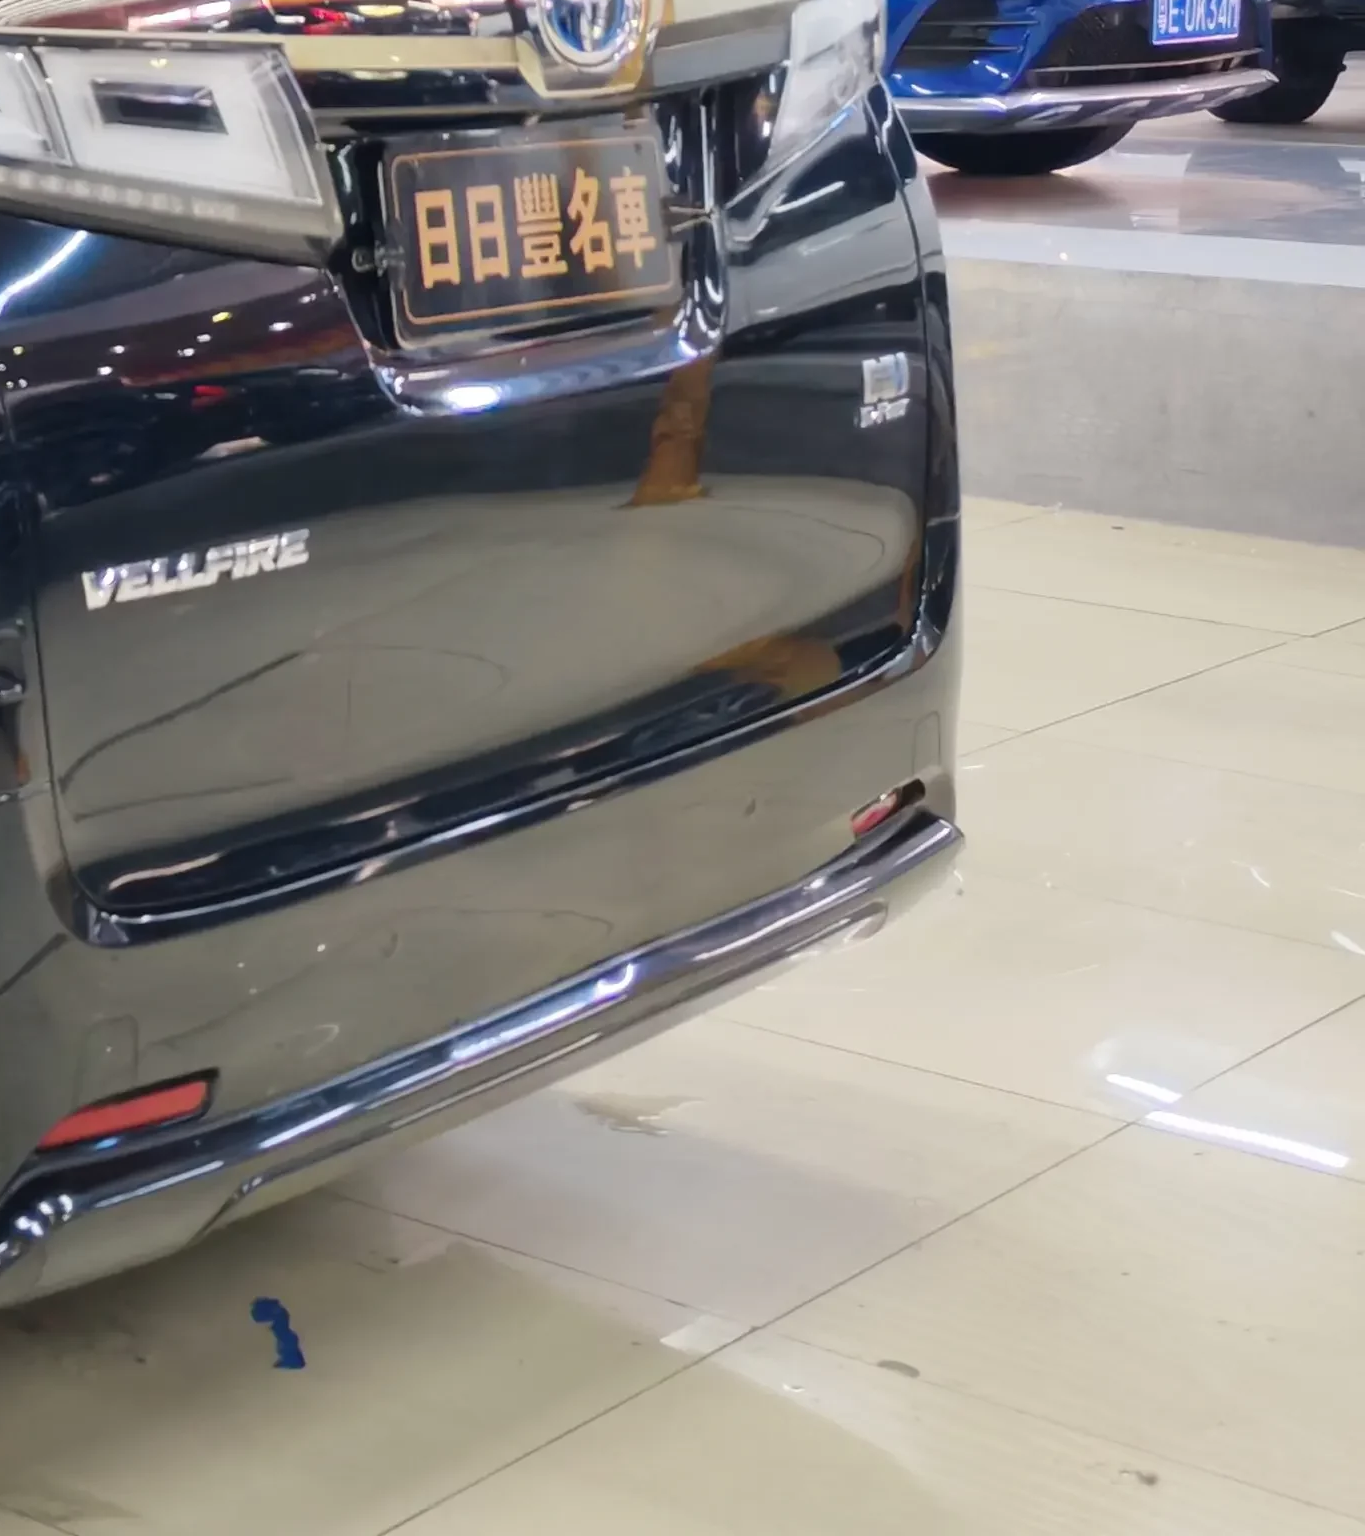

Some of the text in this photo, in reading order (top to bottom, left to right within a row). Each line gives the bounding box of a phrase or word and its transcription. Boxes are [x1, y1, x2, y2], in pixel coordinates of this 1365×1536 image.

[414, 166, 657, 289] 日日豐名車
[81, 528, 310, 611] VELLFIRE
